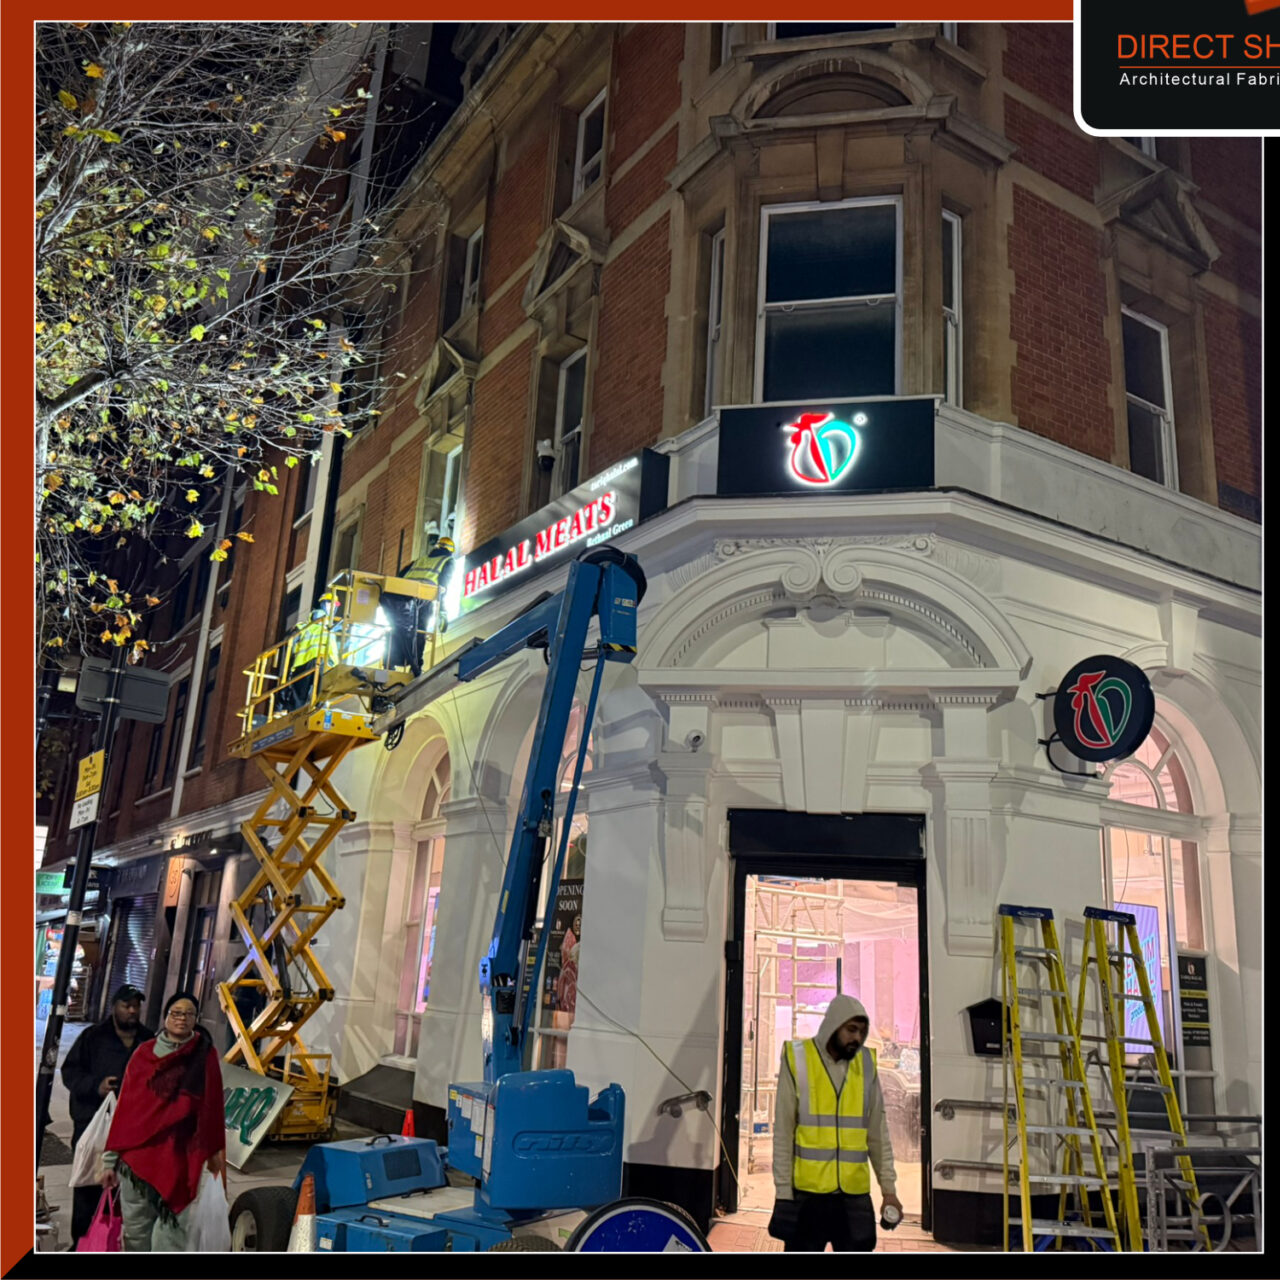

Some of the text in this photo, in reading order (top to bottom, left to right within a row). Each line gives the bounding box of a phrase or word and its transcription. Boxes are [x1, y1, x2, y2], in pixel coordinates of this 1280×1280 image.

[612, 518, 634, 537] Green
[464, 491, 616, 599] HALAL MEATS
[559, 900, 578, 911] SOON
